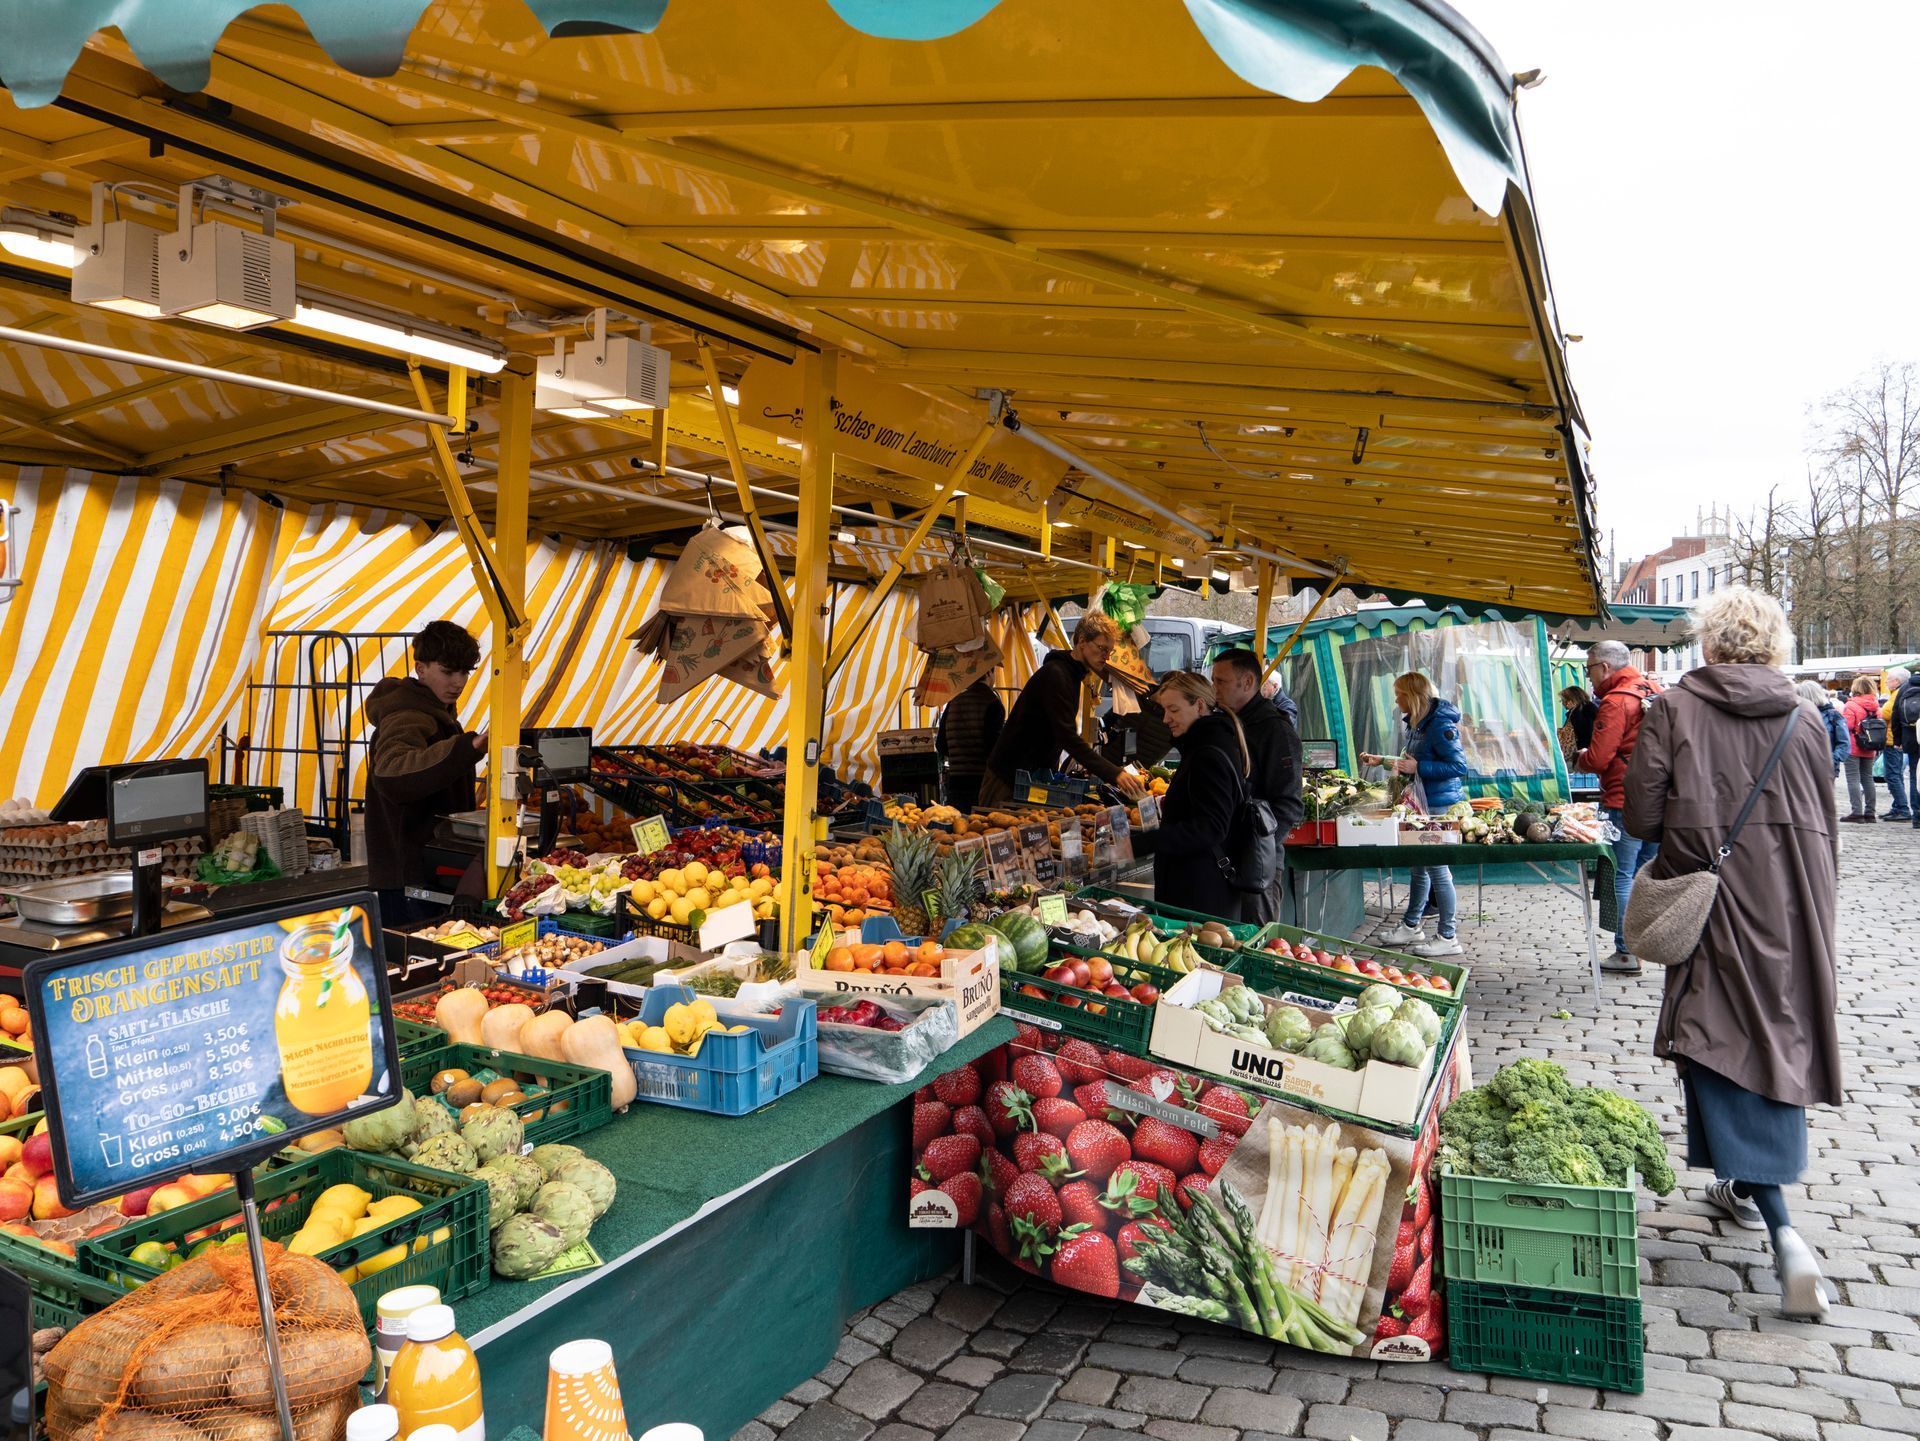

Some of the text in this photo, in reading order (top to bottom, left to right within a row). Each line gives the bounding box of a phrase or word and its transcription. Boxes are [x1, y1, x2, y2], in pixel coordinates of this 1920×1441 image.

[833, 406, 874, 439] sches
[873, 425, 904, 451] vom
[902, 431, 958, 468] Landwirt
[990, 462, 1023, 490] Weiner
[47, 935, 275, 1001] FRISCH GEPRESSTER
[71, 959, 262, 1023] ORANGENSAFT
[962, 968, 994, 1010] BRUÑÓ
[108, 998, 231, 1042] SAFT-FLASCHE
[131, 1035, 155, 1048] Pfand
[114, 1049, 159, 1070] Klein
[203, 1022, 249, 1046] 3,50€
[206, 1039, 251, 1064] 5,50€
[1231, 1048, 1284, 1081] UNO
[119, 1083, 168, 1106] Gross
[208, 1057, 254, 1081] 8,50€
[1284, 1074, 1312, 1089] SABOR
[128, 1127, 174, 1153] Klein
[216, 1101, 262, 1126] 3,00€
[1116, 1089, 1209, 1132] Frisch vom Feld
[131, 1144, 180, 1168] Gross
[219, 1117, 264, 1143] 4,50€
